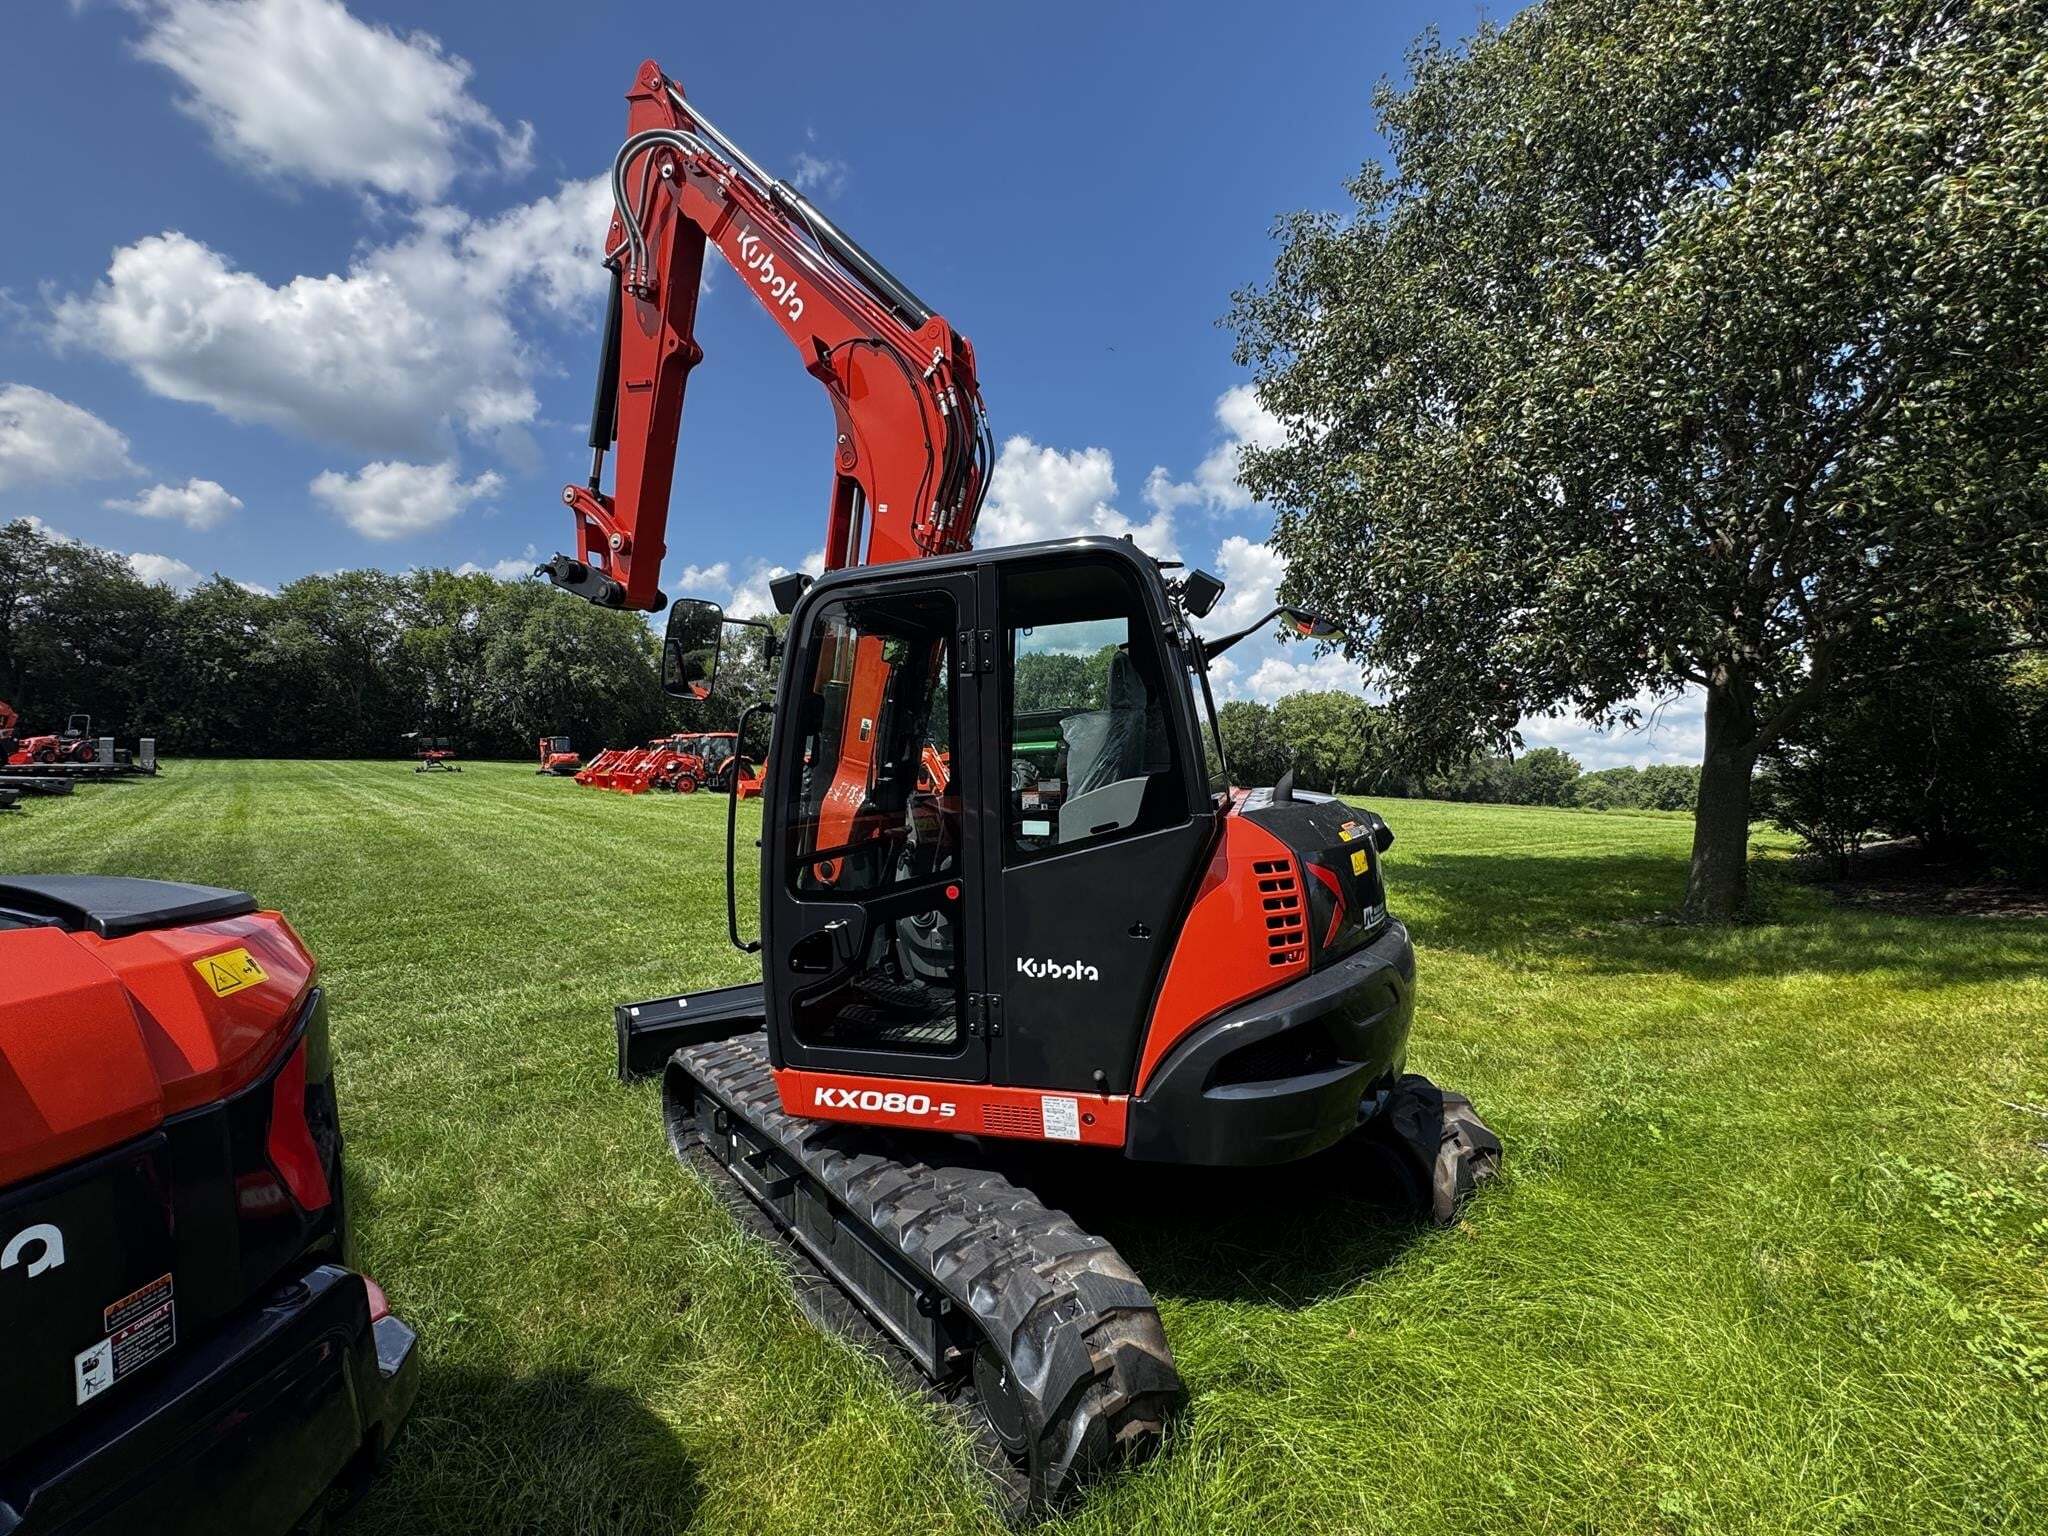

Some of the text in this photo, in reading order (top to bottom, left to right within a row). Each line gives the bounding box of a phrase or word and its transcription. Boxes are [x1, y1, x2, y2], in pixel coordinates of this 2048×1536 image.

[736, 223, 804, 322] Kubota
[1016, 957, 1099, 981] Kubota
[814, 1087, 957, 1117] KX080-5
